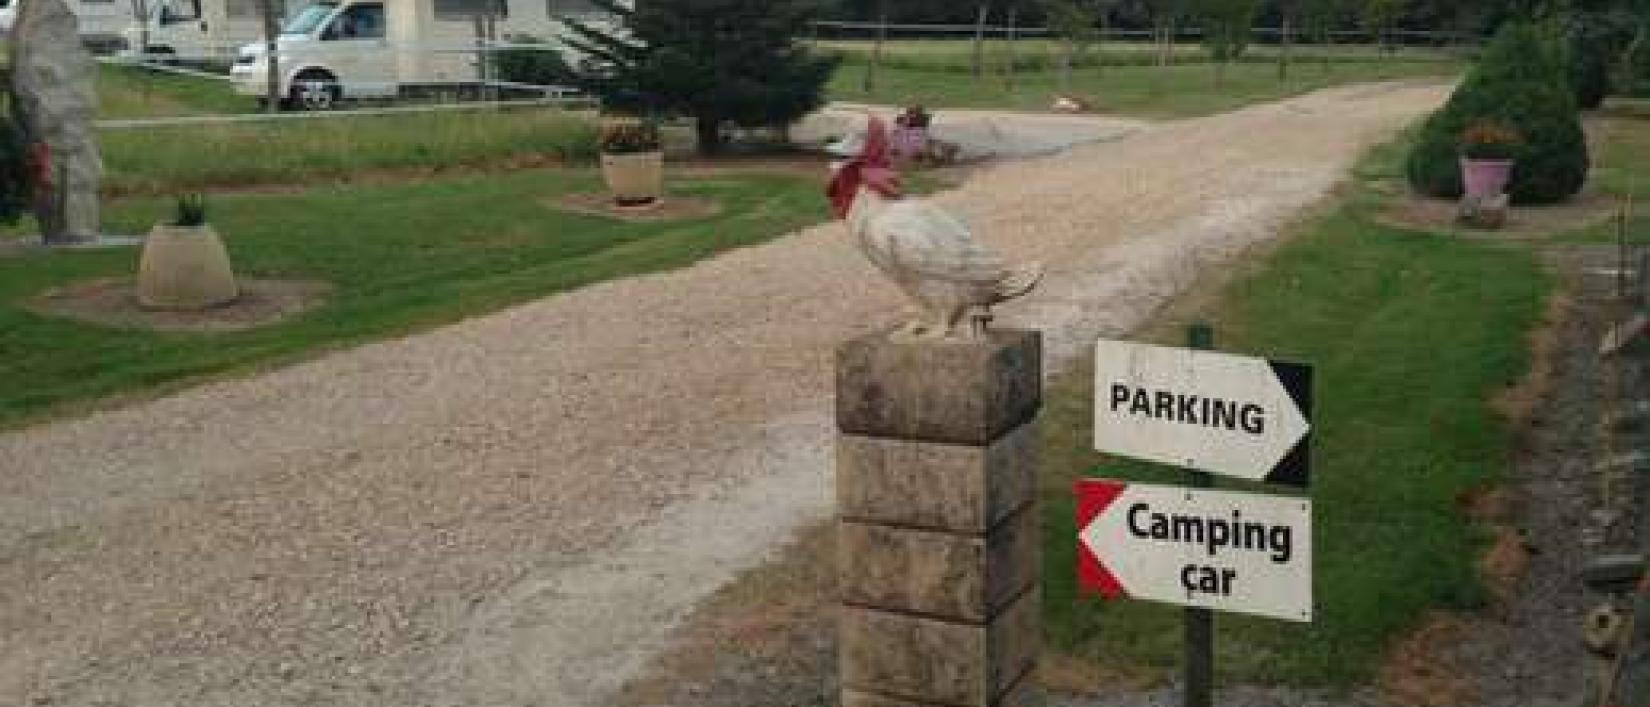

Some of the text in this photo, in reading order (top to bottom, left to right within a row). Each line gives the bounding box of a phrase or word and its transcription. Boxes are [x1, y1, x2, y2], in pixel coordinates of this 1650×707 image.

[1110, 382, 1265, 434] PARKING
[1127, 503, 1292, 563] Camping
[1180, 564, 1237, 597] car
